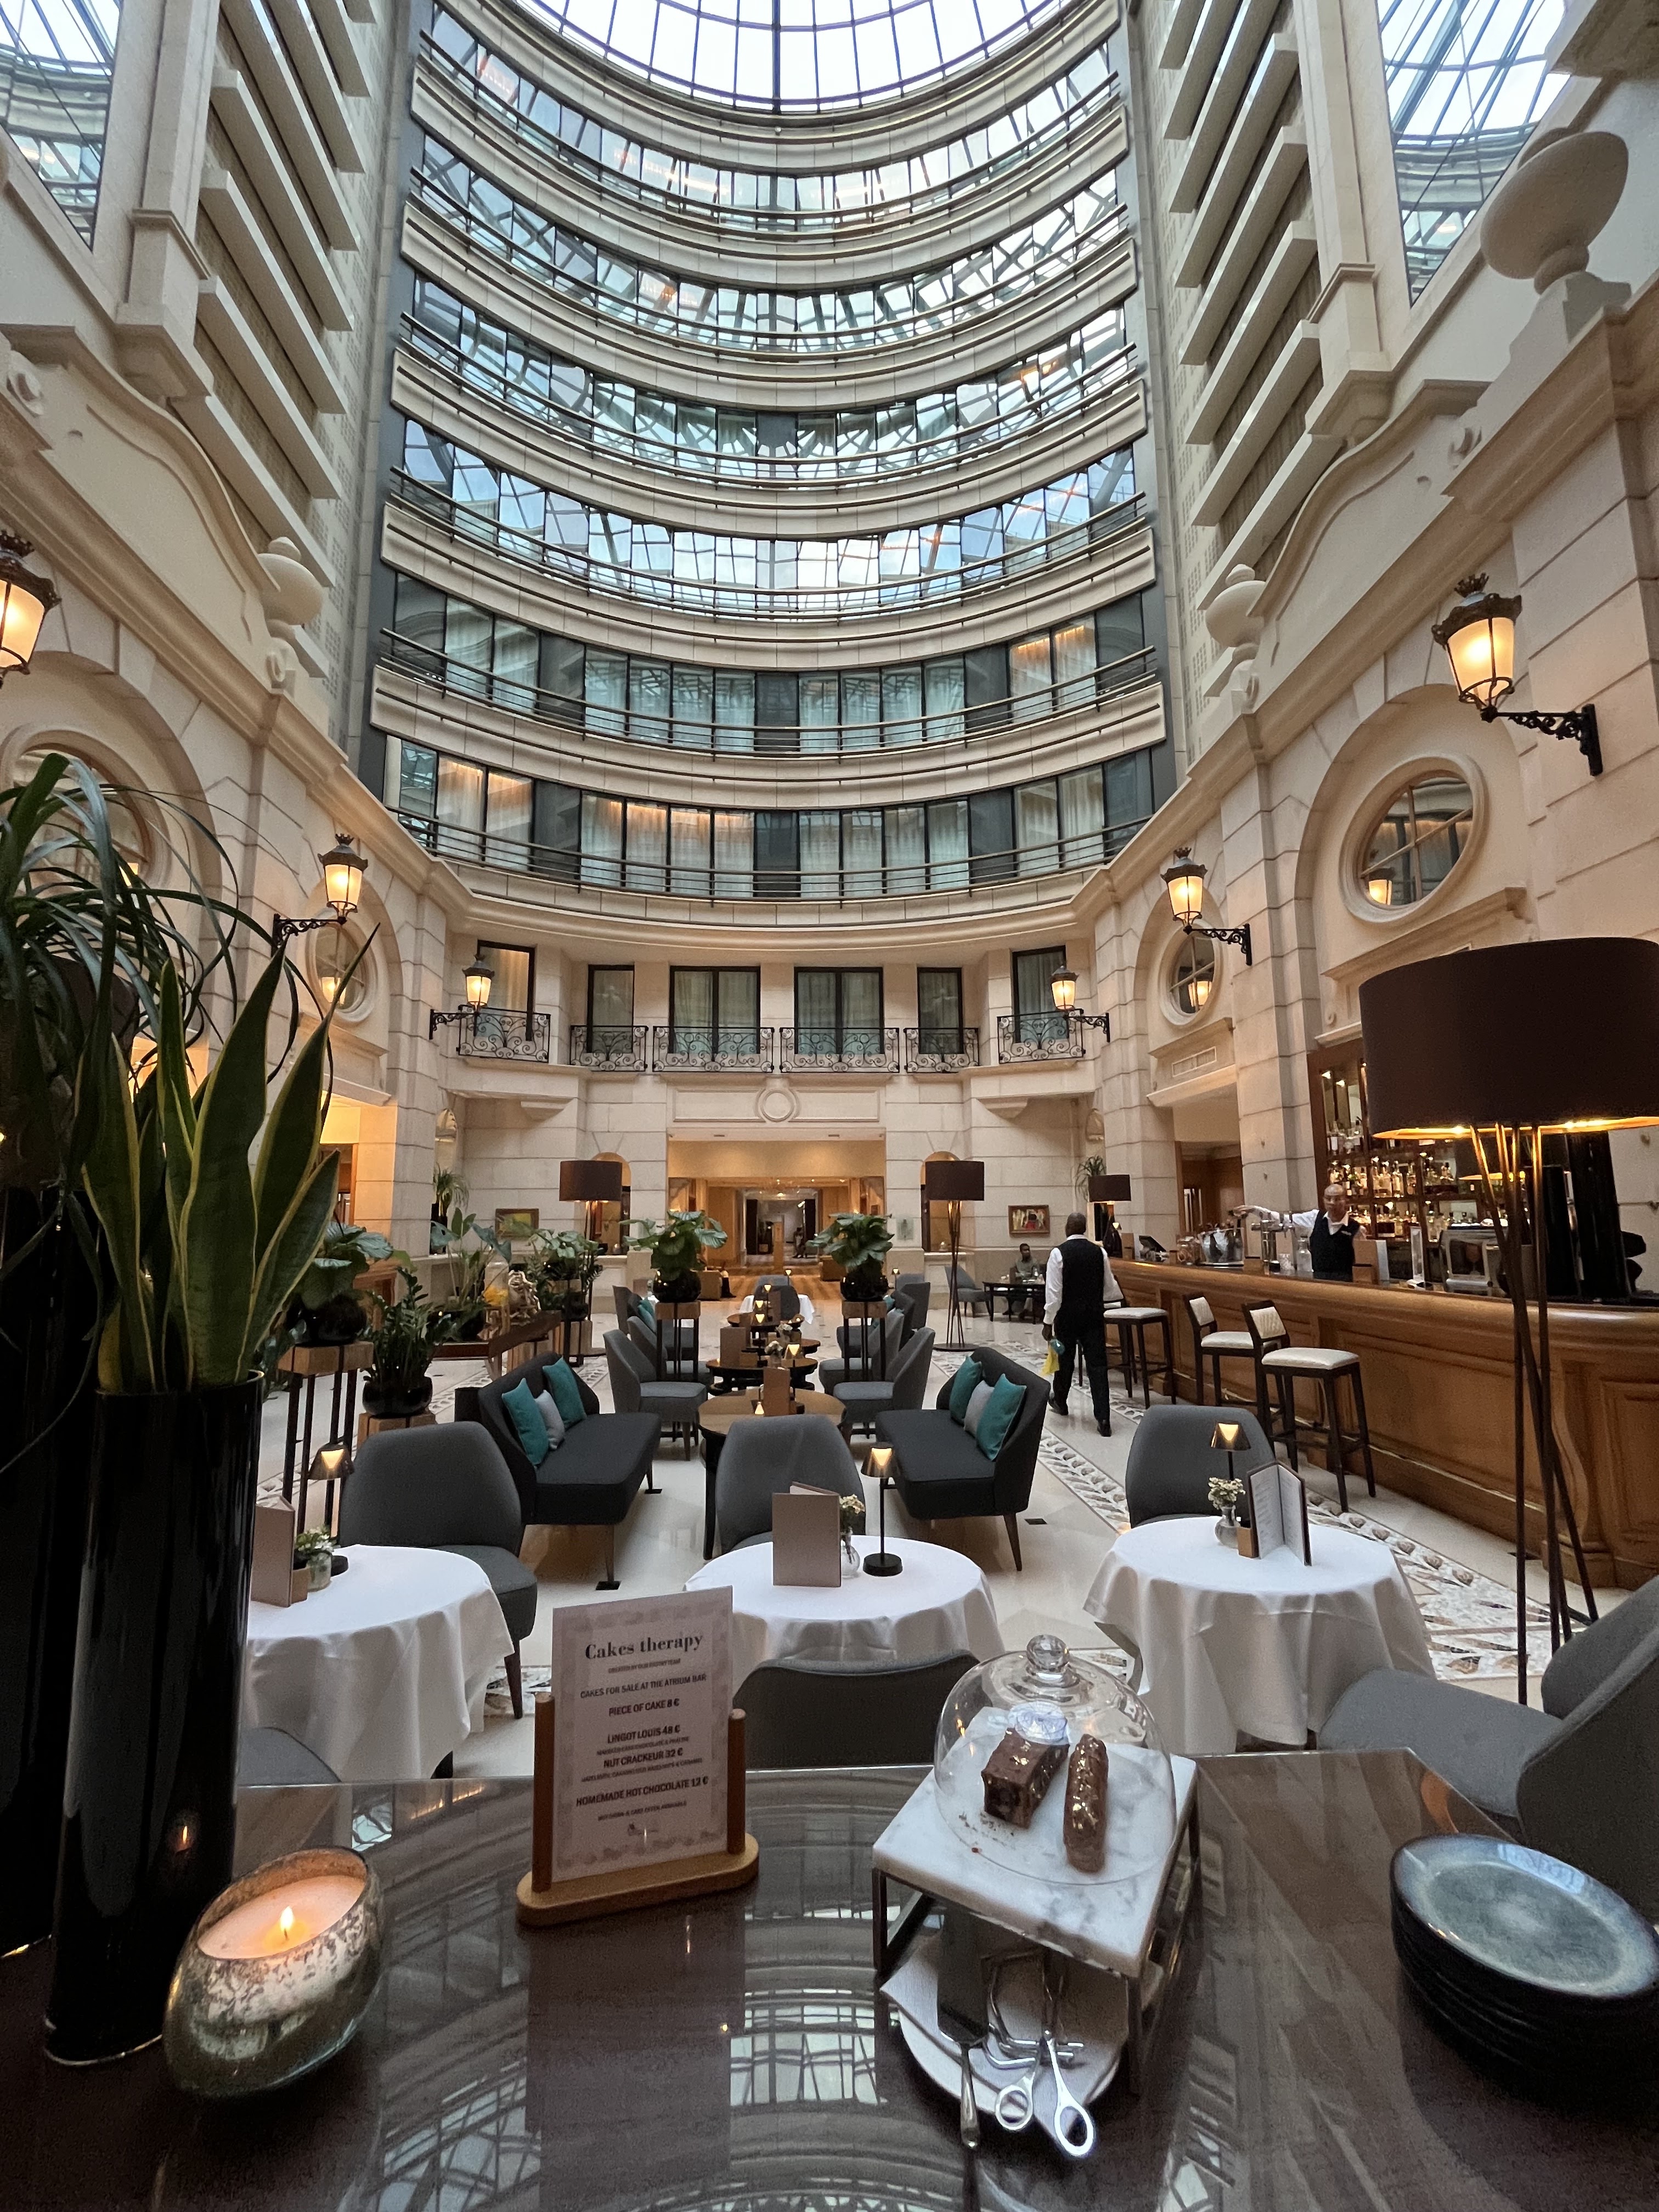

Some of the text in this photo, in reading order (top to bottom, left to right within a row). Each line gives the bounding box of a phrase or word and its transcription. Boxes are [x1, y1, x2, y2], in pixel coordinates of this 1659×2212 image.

[585, 1635, 703, 1660] Cakes therapy
[580, 1673, 707, 1699] CAKES FOR SALE AT THE ATRIUM BAR
[608, 1705, 631, 1717] PIECE
[633, 1703, 644, 1713] OF
[645, 1700, 666, 1711] CAKE
[667, 1699, 673, 1707] 8
[607, 1731, 636, 1744] LINGOT
[637, 1728, 661, 1740] LOUIS
[662, 1725, 673, 1734] 48
[603, 1758, 619, 1769] NUT
[620, 1750, 664, 1766] CRACKEUR
[665, 1748, 675, 1758] 32
[576, 1790, 624, 1807] HOMEMADE
[626, 1786, 641, 1797] HOT
[643, 1779, 689, 1796] CHOCOLATE
[692, 1777, 701, 1787] 12
